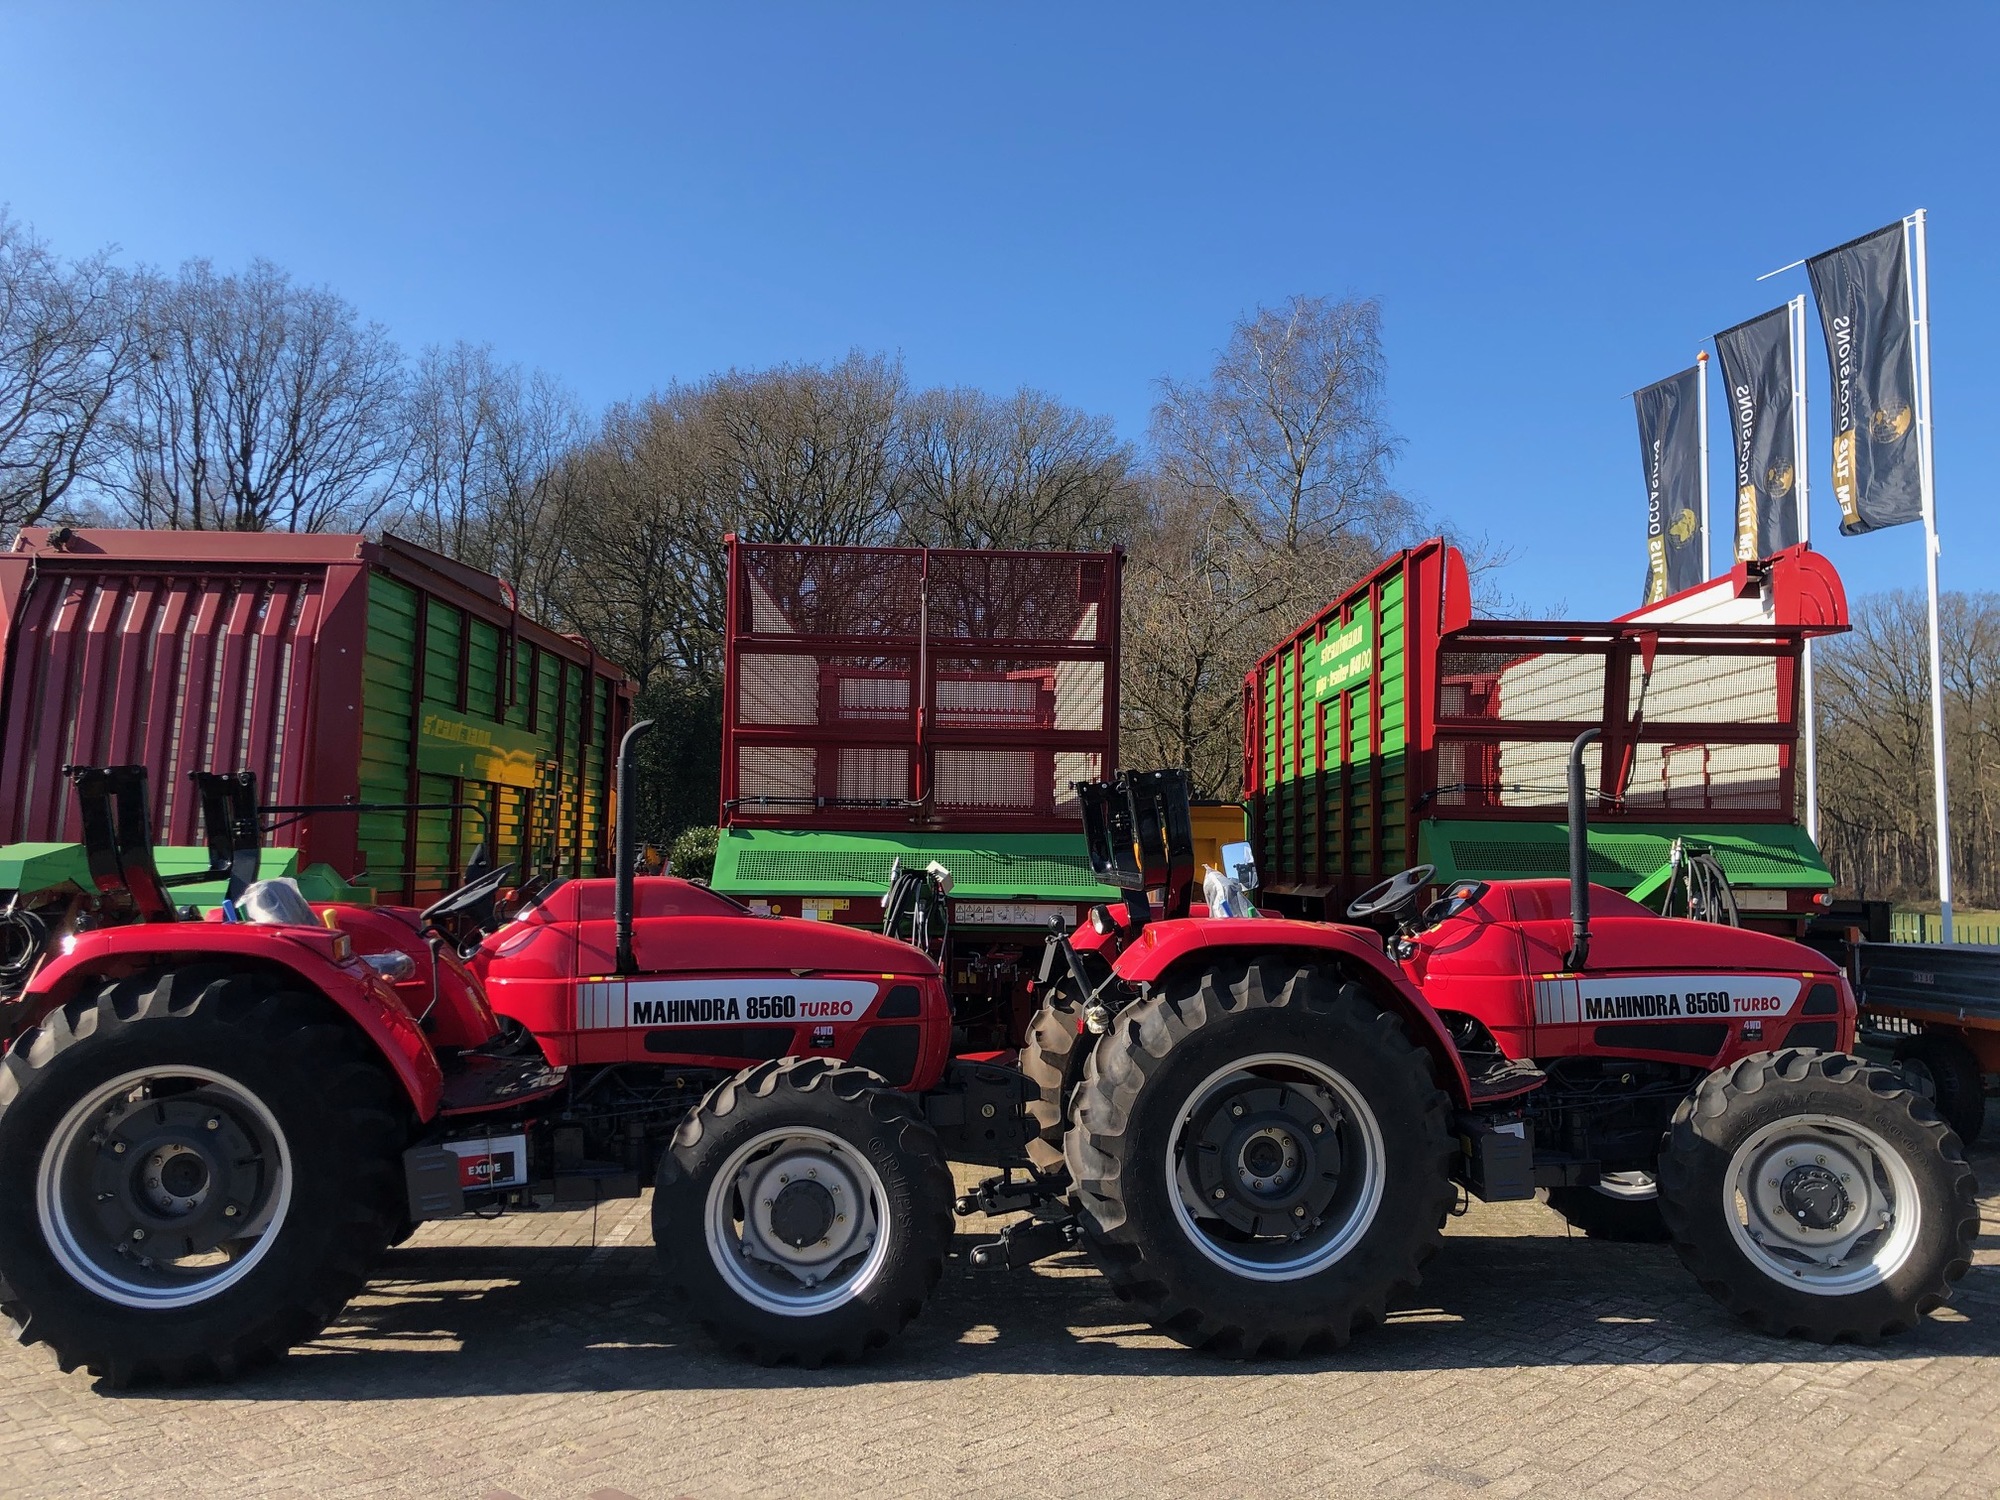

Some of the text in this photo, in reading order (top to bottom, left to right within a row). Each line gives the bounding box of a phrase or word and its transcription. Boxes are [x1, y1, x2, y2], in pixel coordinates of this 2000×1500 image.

[633, 995, 854, 1024] MAHINDRA 8560 TURBO
[1585, 991, 1781, 1020] MAHINDRA 8560 TURBO
[813, 1026, 834, 1036] 4WD
[1743, 1020, 1762, 1030] 4WD
[467, 1163, 501, 1176] EXIDE
